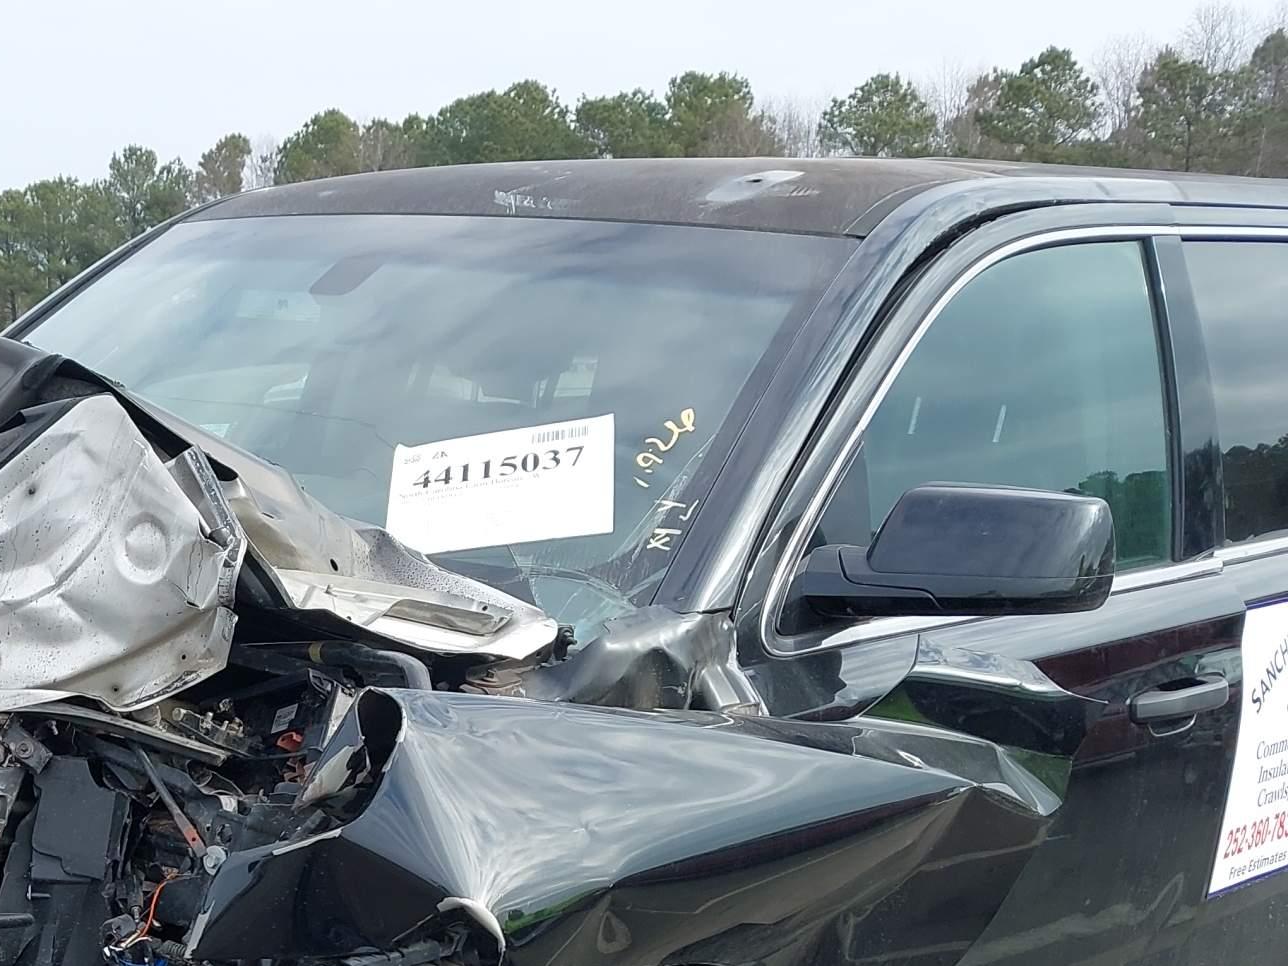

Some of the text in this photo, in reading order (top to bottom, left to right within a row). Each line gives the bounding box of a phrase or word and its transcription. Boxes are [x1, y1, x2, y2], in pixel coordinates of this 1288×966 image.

[412, 446, 585, 488] 44115037
[1252, 634, 1288, 714] SANCH
[1257, 781, 1288, 807] Crawls
[1229, 851, 1287, 880] Free Estimates
